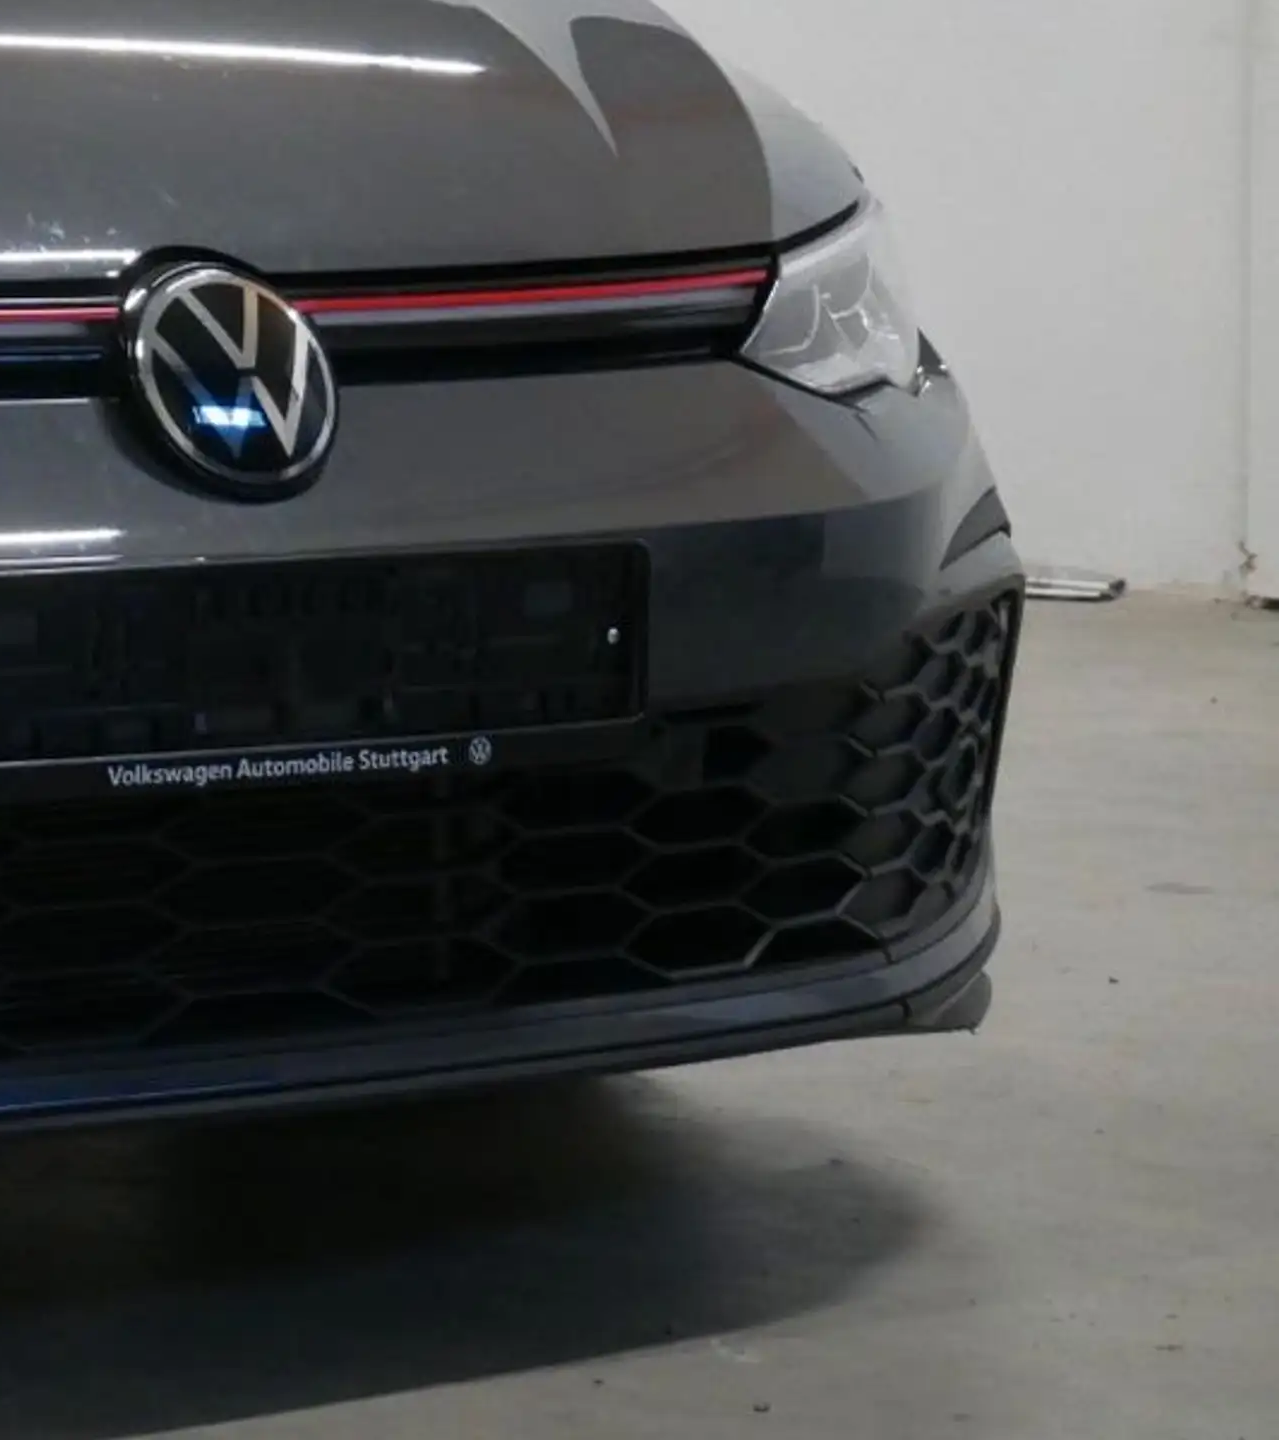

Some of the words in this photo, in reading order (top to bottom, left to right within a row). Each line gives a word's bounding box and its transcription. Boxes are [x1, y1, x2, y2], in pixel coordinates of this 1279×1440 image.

[107, 763, 233, 787] Volkswagen
[237, 750, 354, 779] Automobile
[358, 746, 449, 772] Stuttgart
